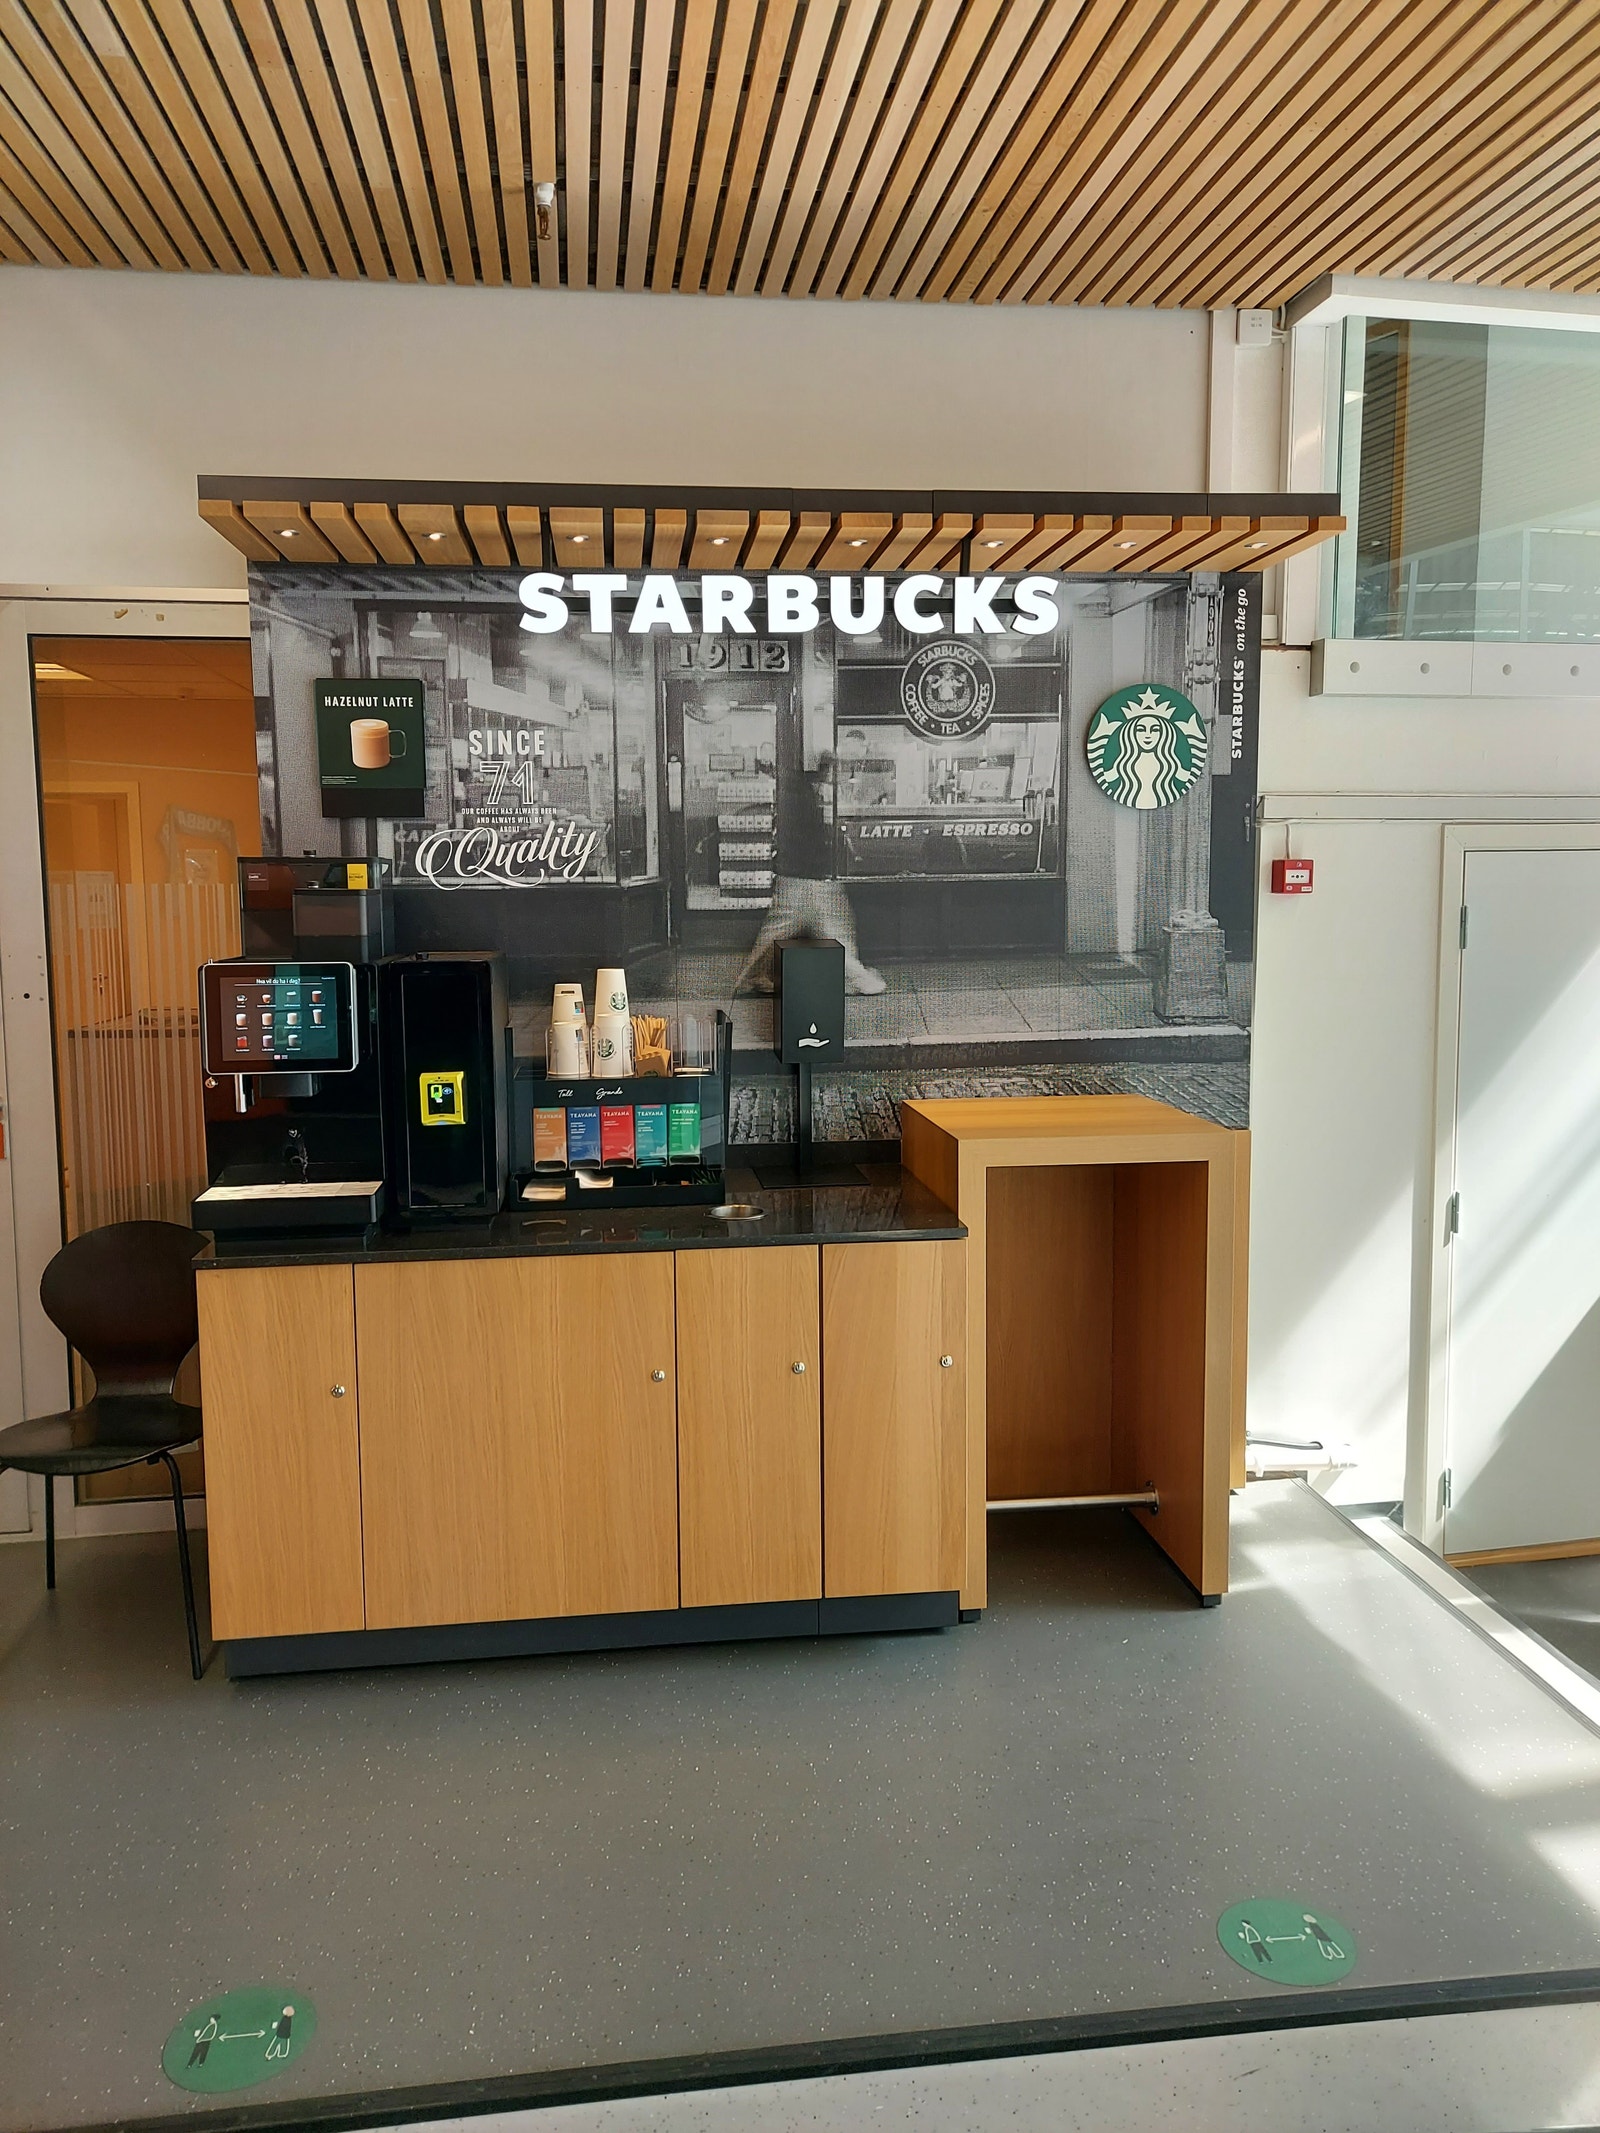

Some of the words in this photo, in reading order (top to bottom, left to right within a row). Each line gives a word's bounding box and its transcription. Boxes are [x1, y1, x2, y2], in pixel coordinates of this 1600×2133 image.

[518, 572, 1060, 635] STARBUCKS
[1237, 588, 1249, 607] go
[1234, 608, 1247, 632] the
[1236, 633, 1246, 651] on
[679, 642, 786, 670] 1912
[918, 645, 978, 667] STARBUCKS
[324, 696, 379, 707] HAZELNUT
[383, 697, 414, 708] LATTE
[905, 684, 929, 726] COFFEE
[971, 683, 990, 720] SPICES
[941, 722, 961, 735] TEA
[468, 729, 545, 756] SINCE
[480, 761, 534, 805] 71
[860, 825, 913, 838] LATTE
[942, 823, 1034, 837] ESPRESSO
[415, 820, 601, 890] Quality
[558, 1089, 574, 1098] Tall
[595, 1087, 623, 1100] Grande
